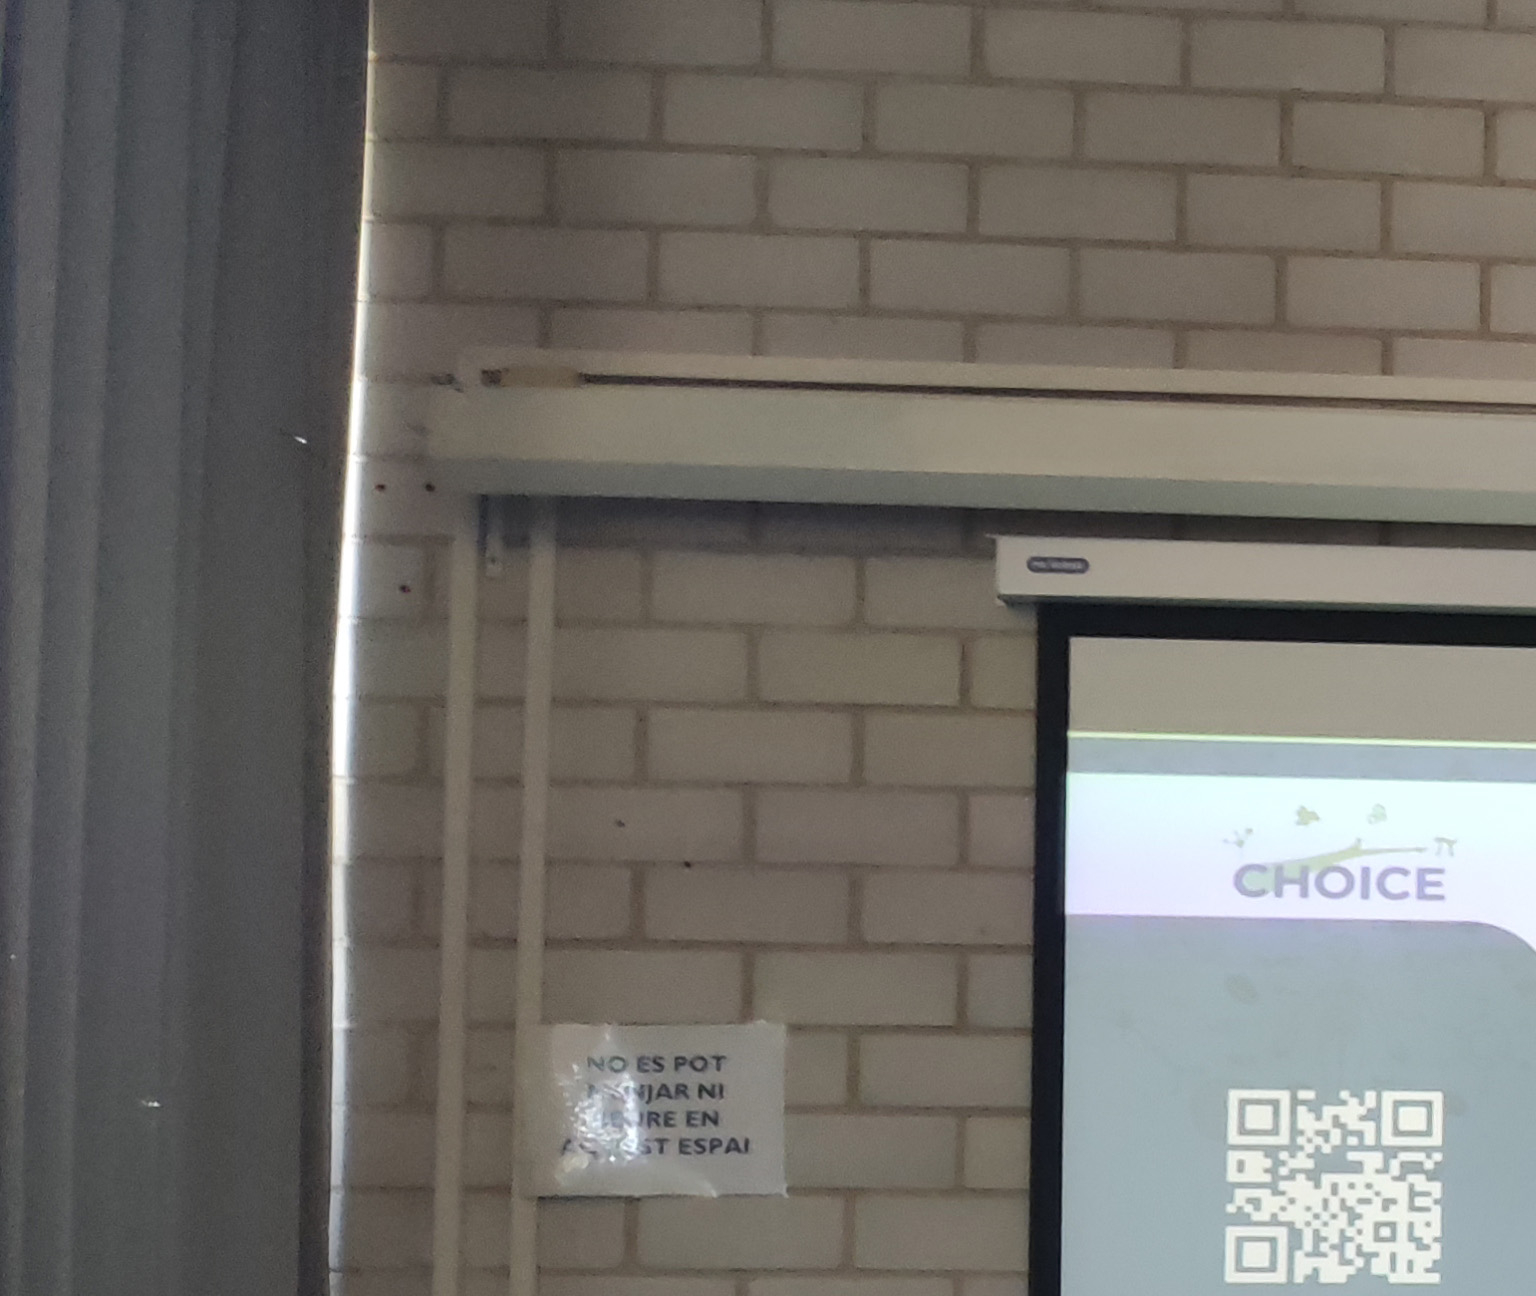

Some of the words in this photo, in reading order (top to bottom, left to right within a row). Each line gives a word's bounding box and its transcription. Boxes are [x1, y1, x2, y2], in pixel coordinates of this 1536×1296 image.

[1233, 863, 1447, 901] CHOICE
[587, 1056, 629, 1073] NO
[636, 1056, 665, 1073] ES
[674, 1055, 727, 1073] POT
[697, 1083, 725, 1100] NI
[686, 1110, 720, 1128] EN
[678, 1138, 750, 1156] ESPAI
